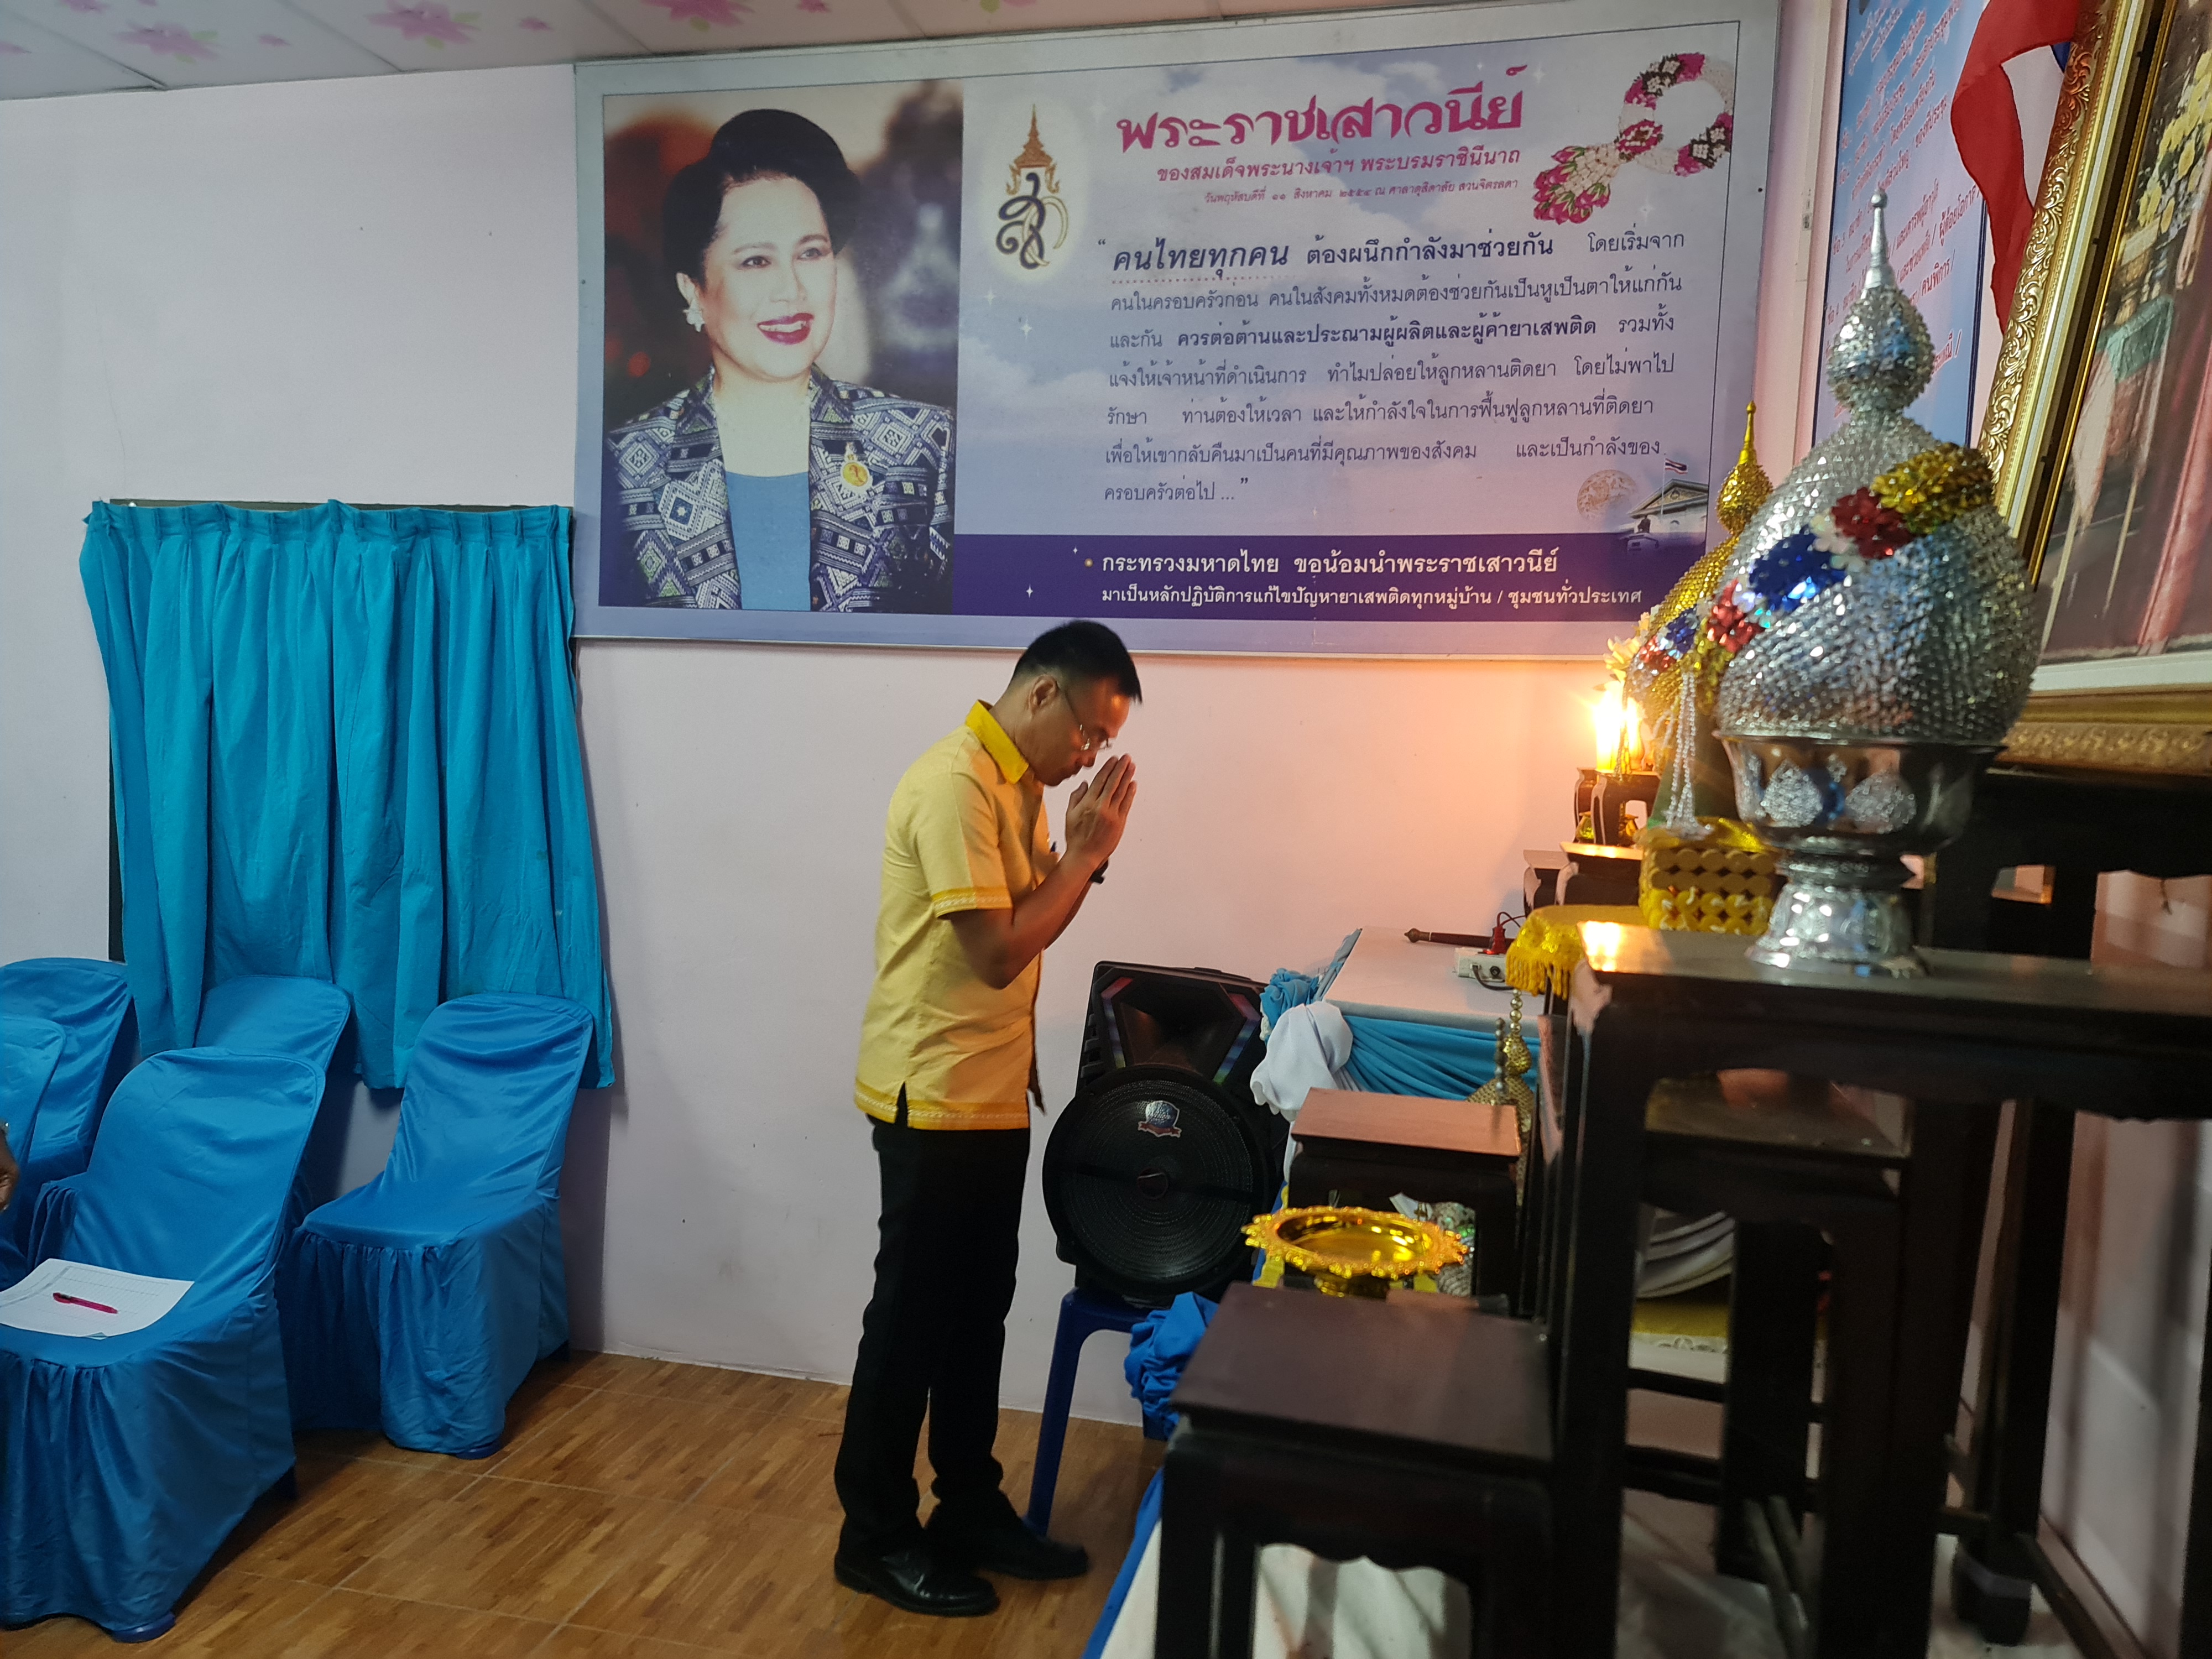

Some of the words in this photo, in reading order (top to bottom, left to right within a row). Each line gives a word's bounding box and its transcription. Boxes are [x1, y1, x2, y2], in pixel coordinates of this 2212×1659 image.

[1116, 64, 1528, 153] พระราชเสาวนีย์
[1157, 148, 1354, 182] ของสมเด็จพระนางเจ้าฯ
[1360, 147, 1520, 173] พระบรมราชินีนาถ
[1204, 186, 1267, 206] วันพฤหัสบดีที่
[1293, 187, 1332, 199] สิงหาคม
[1458, 178, 1519, 192] สวนจิตรลดา
[1112, 238, 1288, 279] คนไทยทุกคน
[1306, 228, 1554, 265] ต้องผนึกกำลังมาช่วยกัน
[1588, 223, 1685, 253] โดยเริ่มจาก
[1111, 281, 1259, 312] คนในครอบครัวก่อน
[1269, 265, 1682, 307] คนในสังคมทั้งหมดต้องช่วยกันเป็นหูเป็นตาให้แก่กัน
[1109, 329, 1164, 349] และกัน
[1177, 311, 1597, 347] ควรต่อต้านและประณามผู้ผลิตและผู้ค้ายาเสพติด
[1618, 303, 1674, 334] รวมทั้ง
[1109, 358, 1307, 388] แจ้งให้เจ้าหน้าที่ดำเนินการ
[1327, 352, 1557, 385] ทำไมปล่อยให้ลูกหลานติดยา
[1574, 347, 1676, 375] โดยไม่พาไป
[1107, 406, 1147, 425] รักษา
[1182, 396, 1302, 425] ท่านต้องให้เวลา
[1312, 388, 1654, 424] และให้กำลังใจในการฟื้นฟูลูกหลานที่ติดยา
[1105, 435, 1477, 467] เพื่อให้เขากลับคืนมาเป็นคนที่มีคุณภาพของสังคม
[1516, 437, 1661, 458] และเป็นกำลังของ
[1104, 474, 1216, 502] ครอบครัวต่อไป
[1102, 549, 1279, 573] กระทรวงมหาดไทย
[1293, 546, 1560, 574] ขอน้อมนำพระราชเสาวนีย์
[1102, 584, 1492, 610] มาเป็นหลักปฏิบัติการแก้ไขปัญหายาเสพติดทุกหมู่บ้าน
[1507, 579, 1643, 610] ชุมชนทั่วประเทศ
